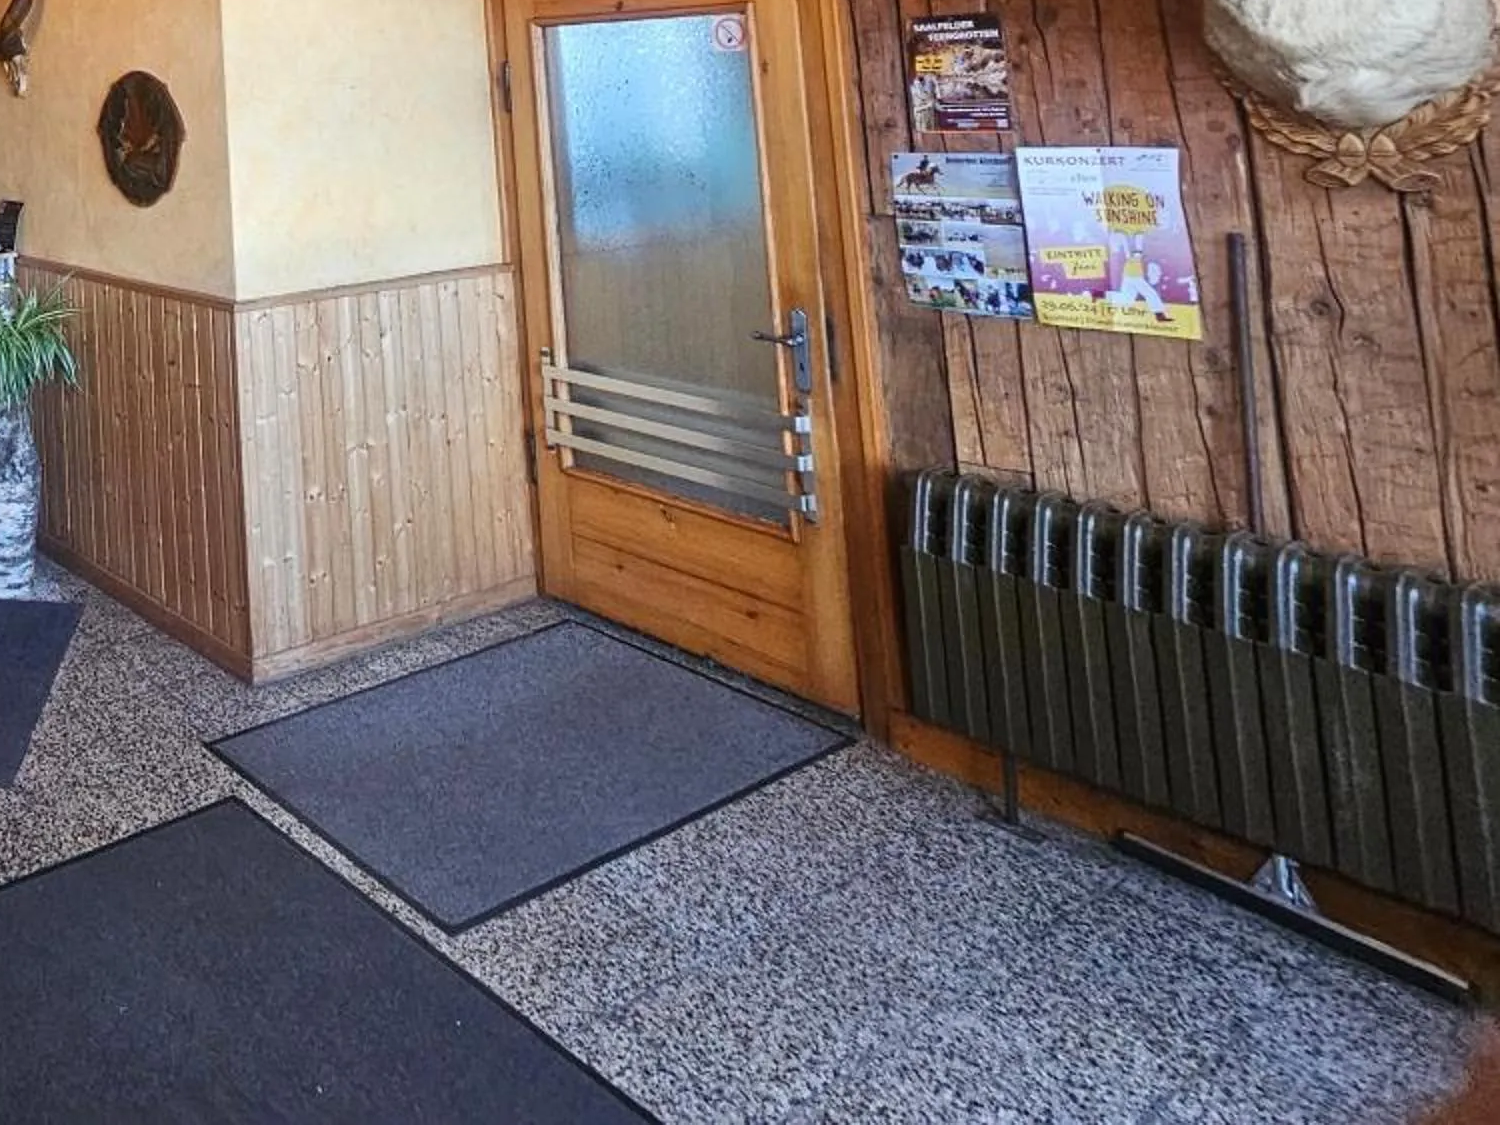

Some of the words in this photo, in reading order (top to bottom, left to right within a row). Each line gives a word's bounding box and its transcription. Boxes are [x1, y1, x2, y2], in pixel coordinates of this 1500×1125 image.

[1024, 156, 1125, 166] KURKONZERT
[1082, 190, 1139, 207] WALKING
[1145, 193, 1165, 209] ON
[1095, 208, 1158, 225] SUNSHINE
